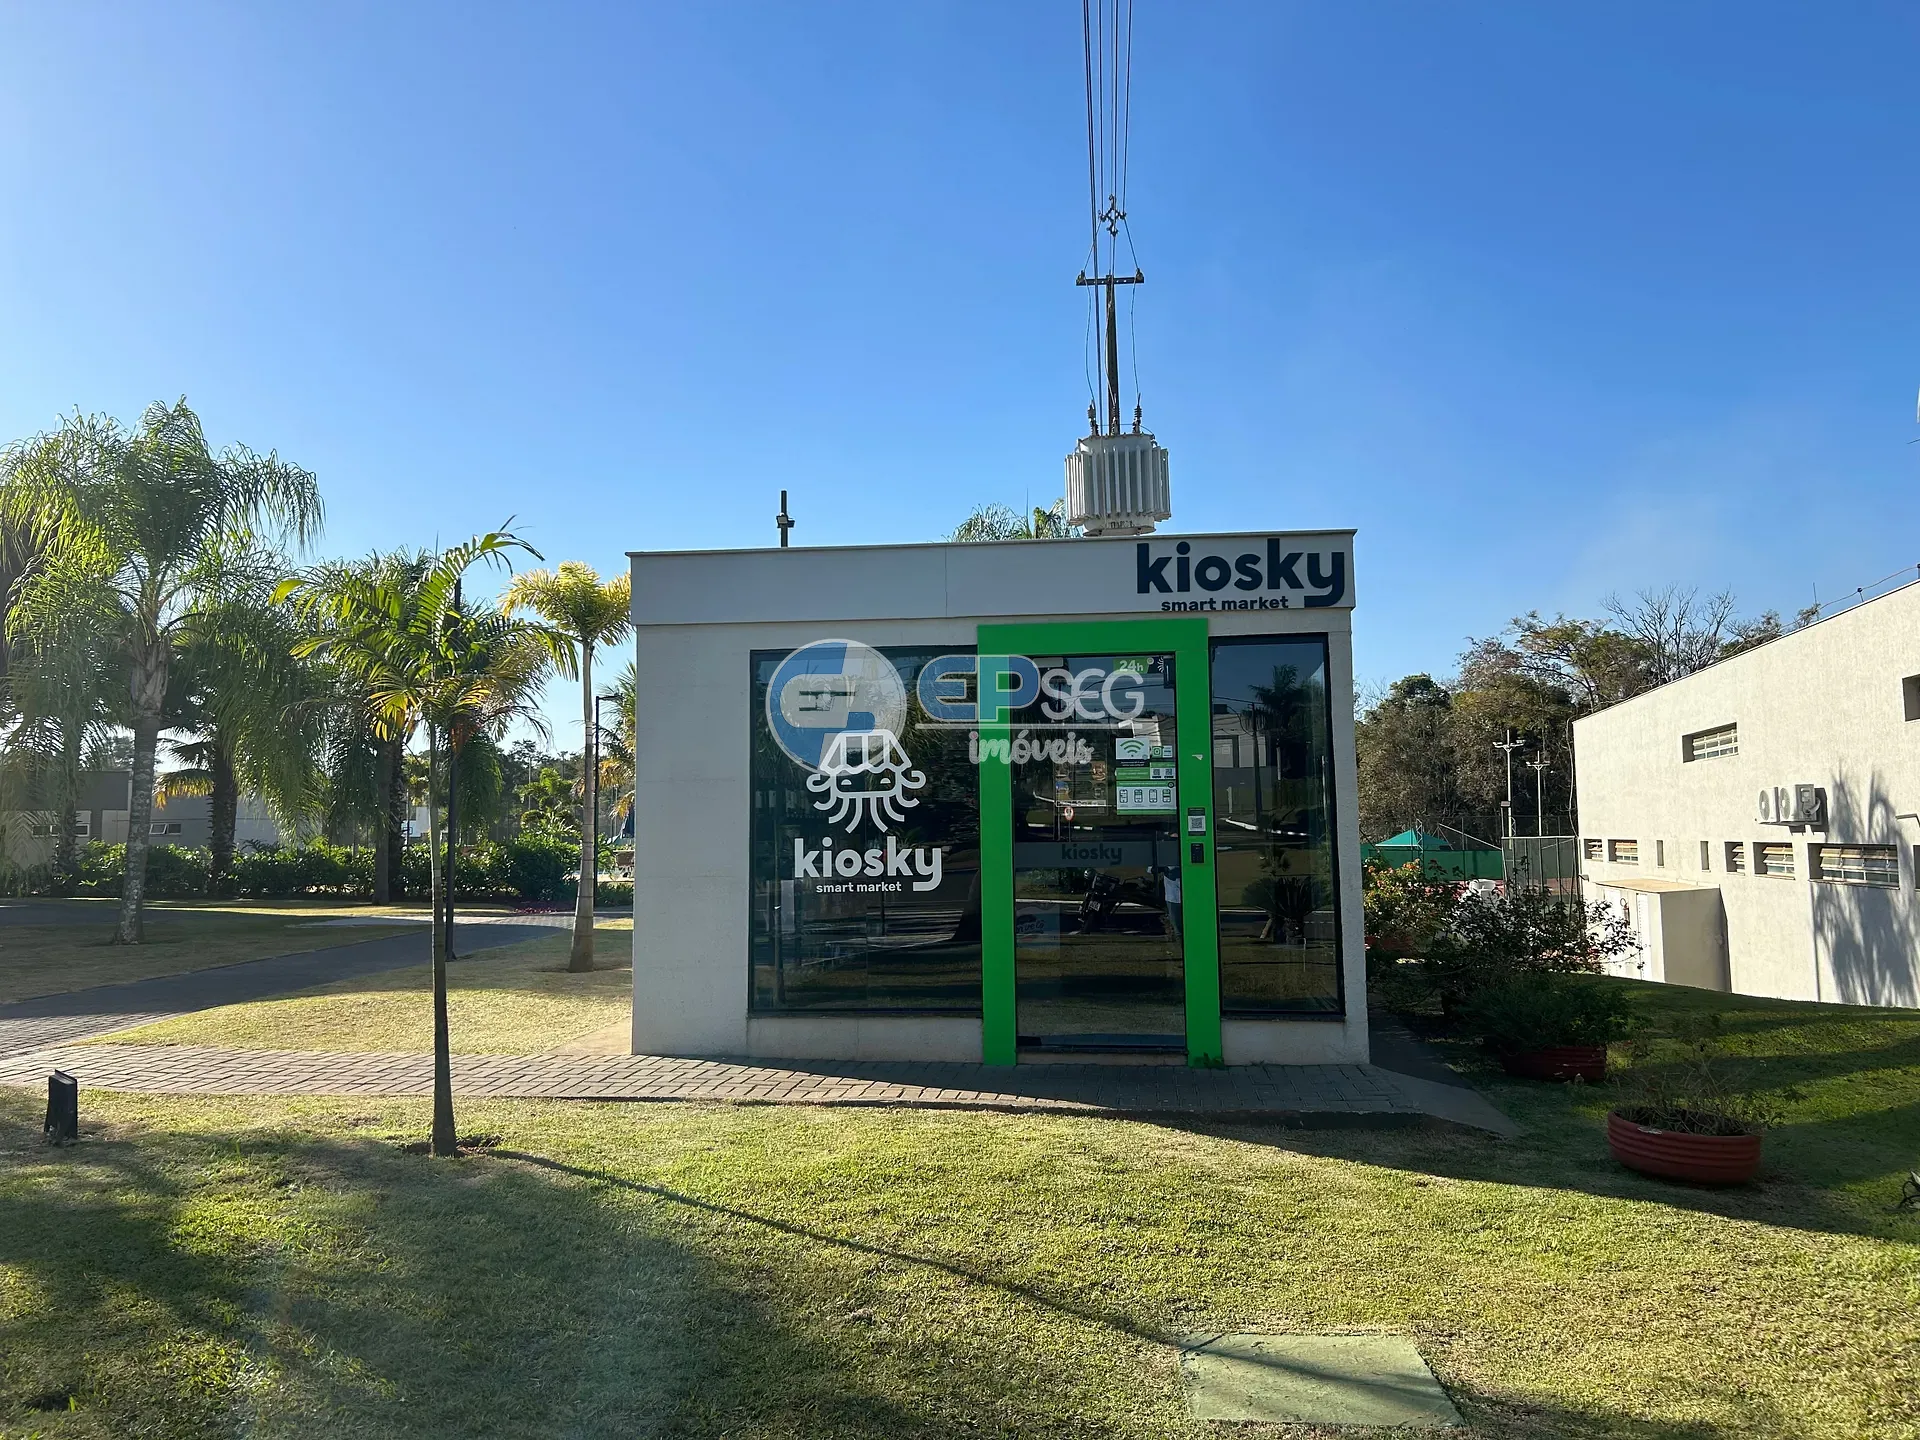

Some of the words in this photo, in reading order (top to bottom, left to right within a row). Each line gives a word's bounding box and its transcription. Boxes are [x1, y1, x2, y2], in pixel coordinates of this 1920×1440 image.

[1137, 538, 1345, 608] kiosky
[1161, 598, 1216, 611] smart
[1221, 596, 1289, 611] market
[794, 835, 943, 892] kiosky
[1061, 842, 1123, 866] kiosky
[816, 882, 853, 893] smart
[856, 881, 902, 893] market
